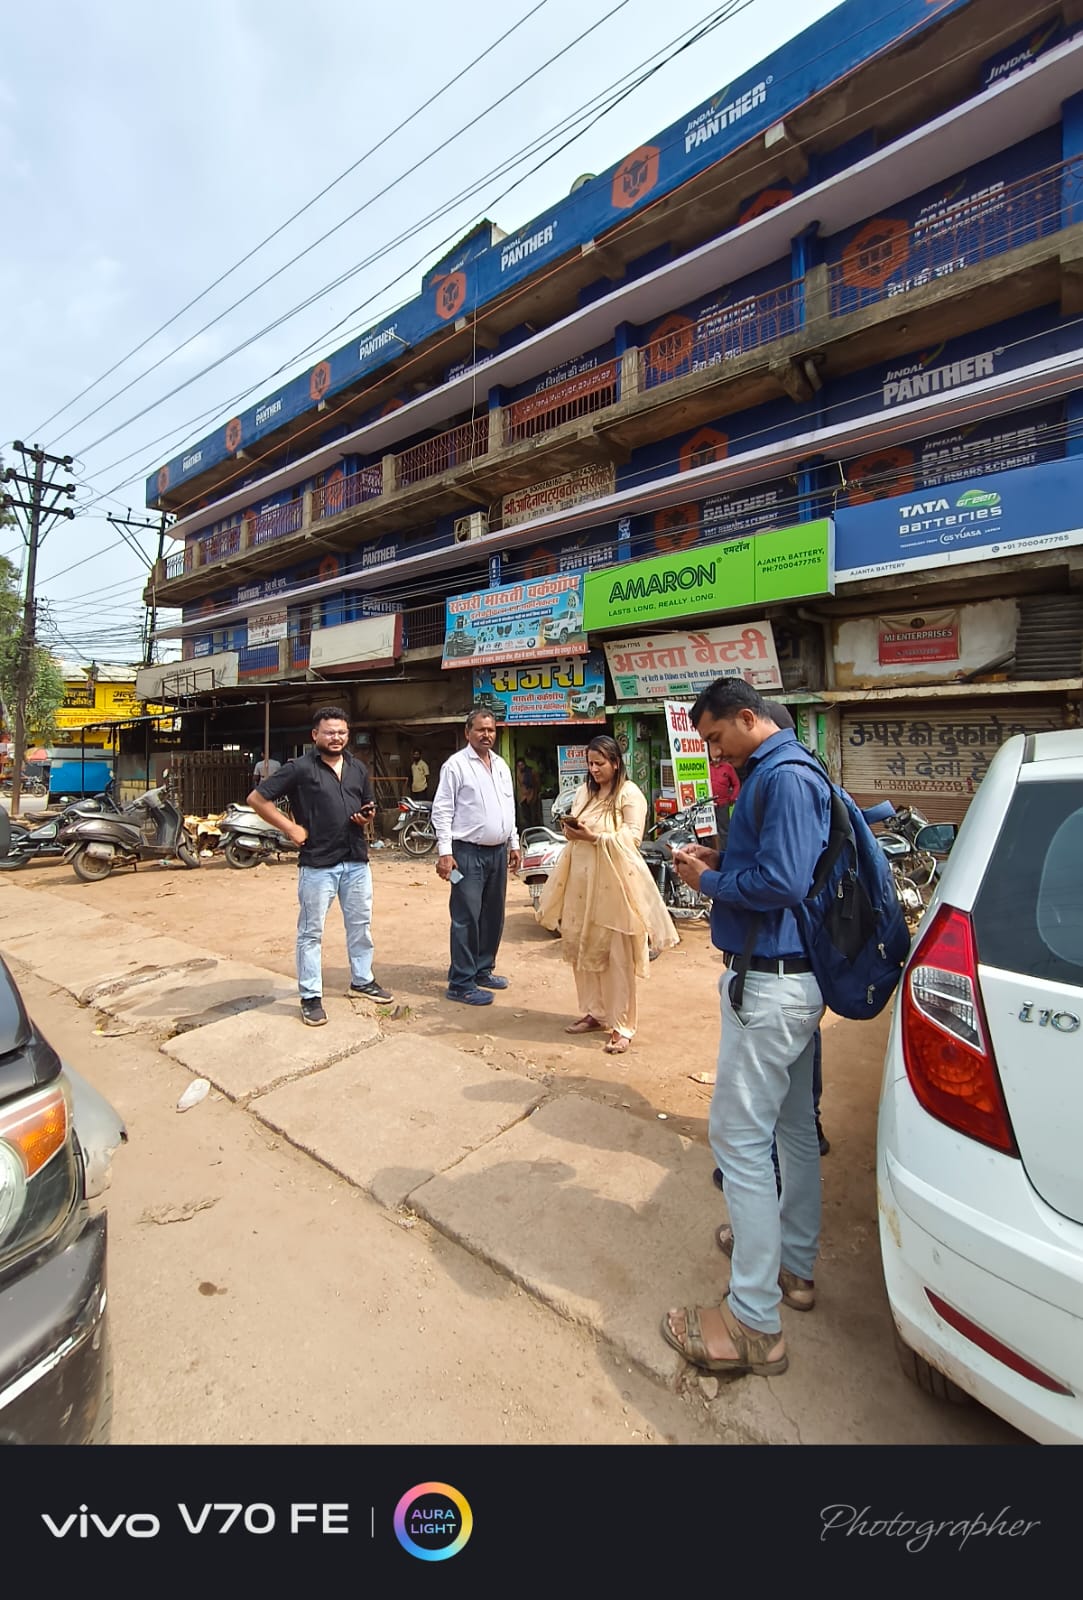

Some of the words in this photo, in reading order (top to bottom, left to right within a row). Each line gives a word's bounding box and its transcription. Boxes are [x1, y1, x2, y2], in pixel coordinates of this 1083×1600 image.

[985, 48, 1033, 84] JINDAL
[684, 105, 716, 134] JINDAL
[685, 80, 767, 154] PANTHER
[501, 224, 554, 273] PANTHER
[360, 326, 395, 361] PANTHER
[883, 361, 924, 384] JINDAL
[883, 352, 995, 407] PANTHER
[899, 498, 950, 519] TATA
[953, 527, 982, 540] YUASA
[1002, 542, 1015, 551] +91
[1017, 534, 1070, 549] 7000477765
[363, 545, 396, 567] PANTHER
[723, 540, 751, 556] एमरॉन
[757, 553, 786, 566] AJANTA
[788, 548, 825, 562] BATTERY,
[850, 567, 876, 576] AJANTA
[876, 562, 906, 573] BATTERY
[608, 561, 716, 604] AMARON
[608, 606, 631, 617] LASTS
[633, 603, 657, 615] LONG,
[658, 597, 688, 608] REALLY
[896, 629, 953, 641] ENTERPRISES
[613, 641, 689, 674] अजंता
[687, 628, 769, 665] बैटरी
[849, 719, 906, 747] ऊपर
[906, 721, 935, 747] की
[680, 738, 706, 753] EXIDE
[678, 762, 705, 771] AMARON
[887, 752, 909, 777] से
[914, 751, 965, 780] देना
[1019, 1000, 1081, 1033] i10
